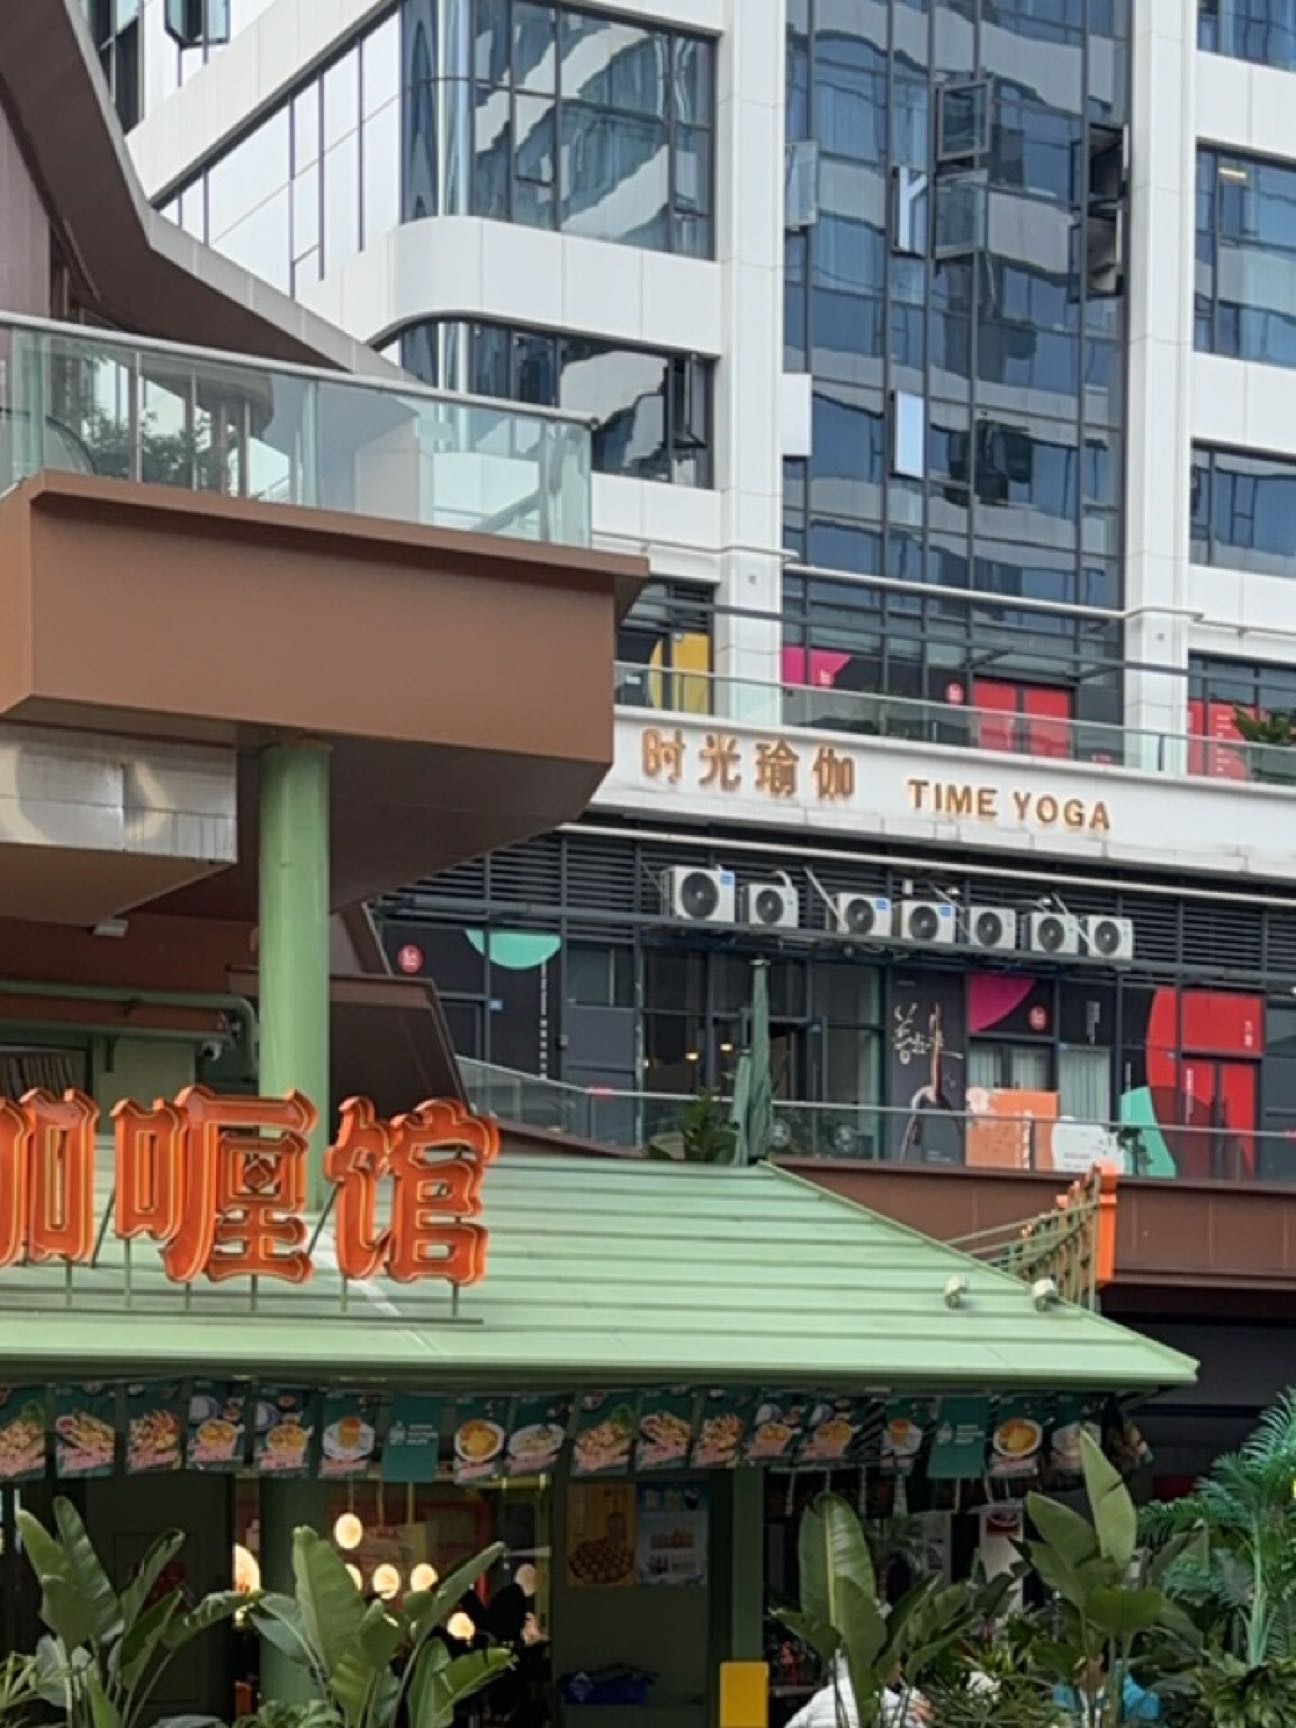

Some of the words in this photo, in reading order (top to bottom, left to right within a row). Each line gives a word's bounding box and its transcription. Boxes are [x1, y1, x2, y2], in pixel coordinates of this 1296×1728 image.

[640, 727, 856, 801] 时光瑜伽
[908, 779, 999, 817] TIME
[1014, 791, 1112, 831] YOGA
